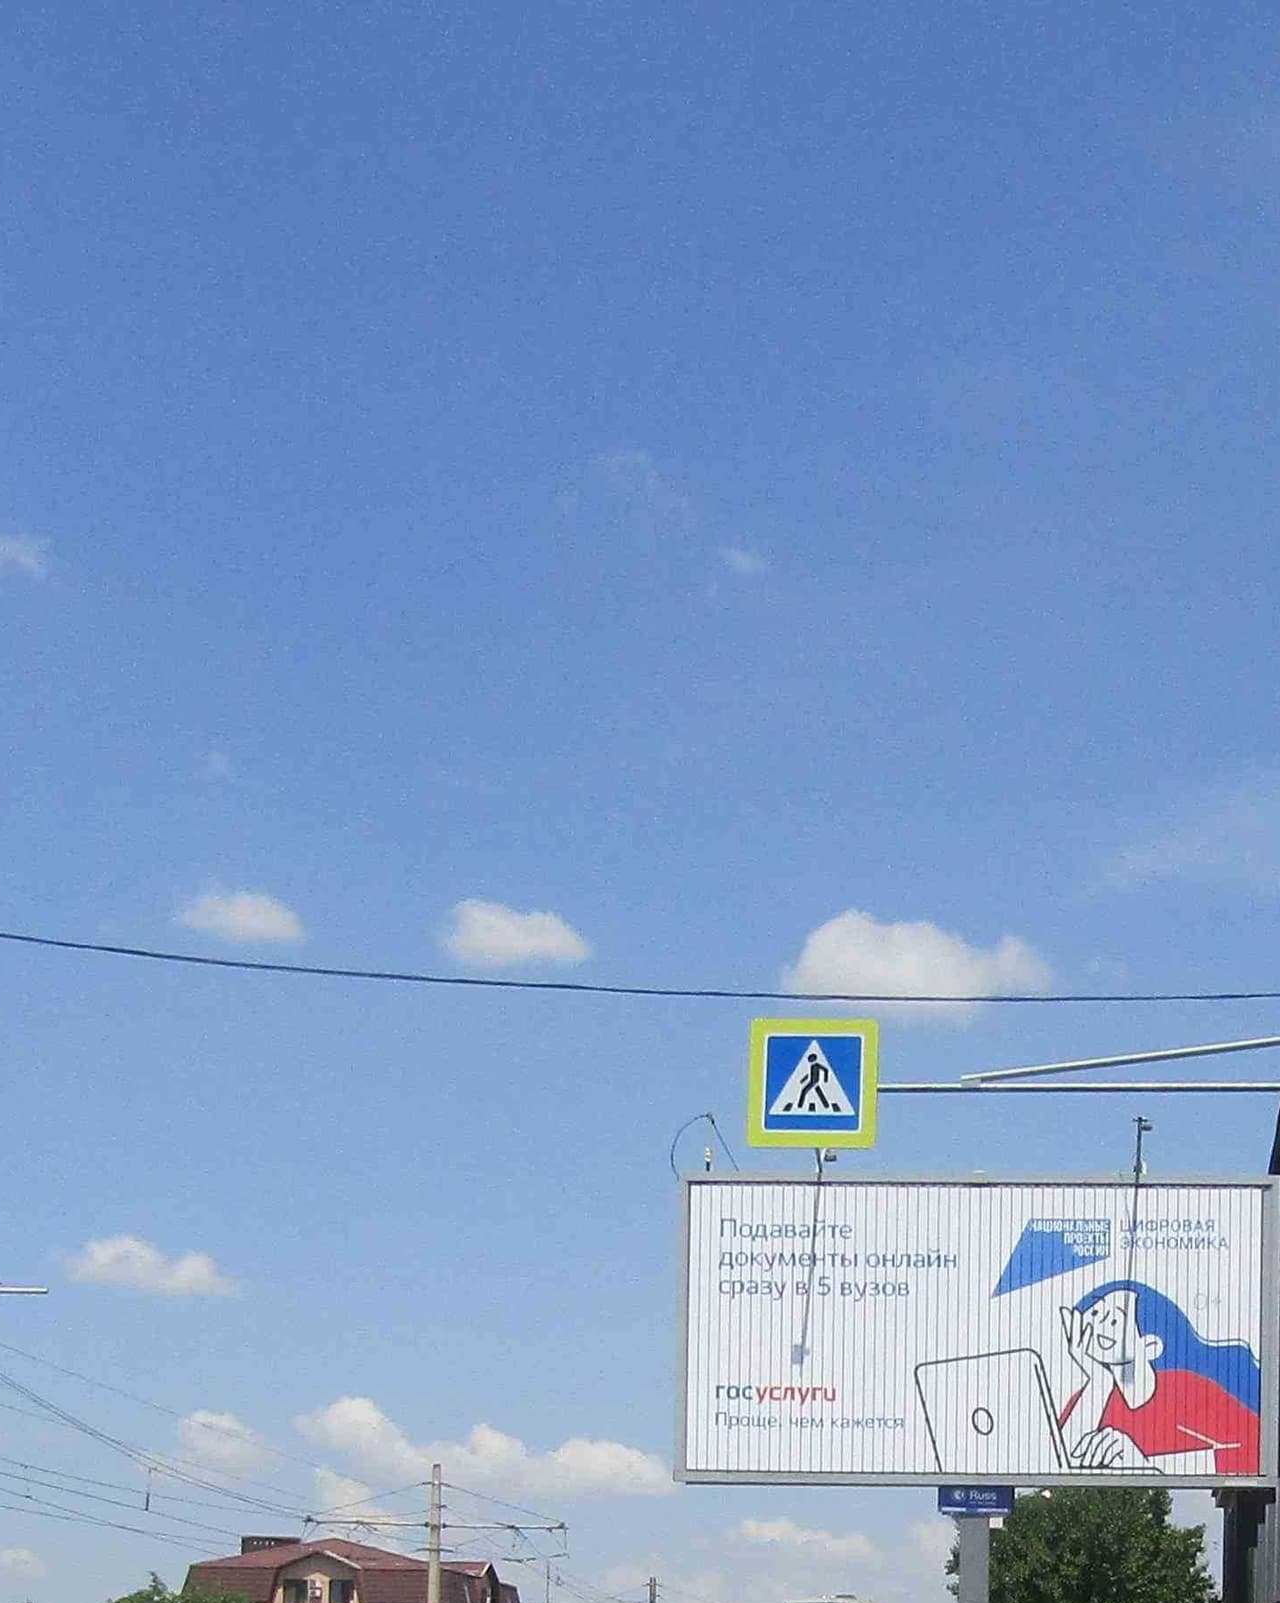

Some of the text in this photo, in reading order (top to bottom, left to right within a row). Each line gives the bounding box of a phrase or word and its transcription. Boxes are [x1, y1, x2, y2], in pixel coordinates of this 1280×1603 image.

[719, 1218, 853, 1242] Подавайте
[1119, 1219, 1215, 1234] ЦИФРОВАЯ
[1063, 1232, 1110, 1245] ПРОЕКТЫ
[1120, 1236, 1229, 1250] ЭКОНОМИКА
[718, 1249, 958, 1272] документы онлайн
[718, 1276, 910, 1302] сразу в 5 вузов
[715, 1385, 837, 1406] госуслуги
[790, 1417, 824, 1429] чем
[831, 1417, 905, 1430] кажется
[969, 1490, 997, 1501] Russ
